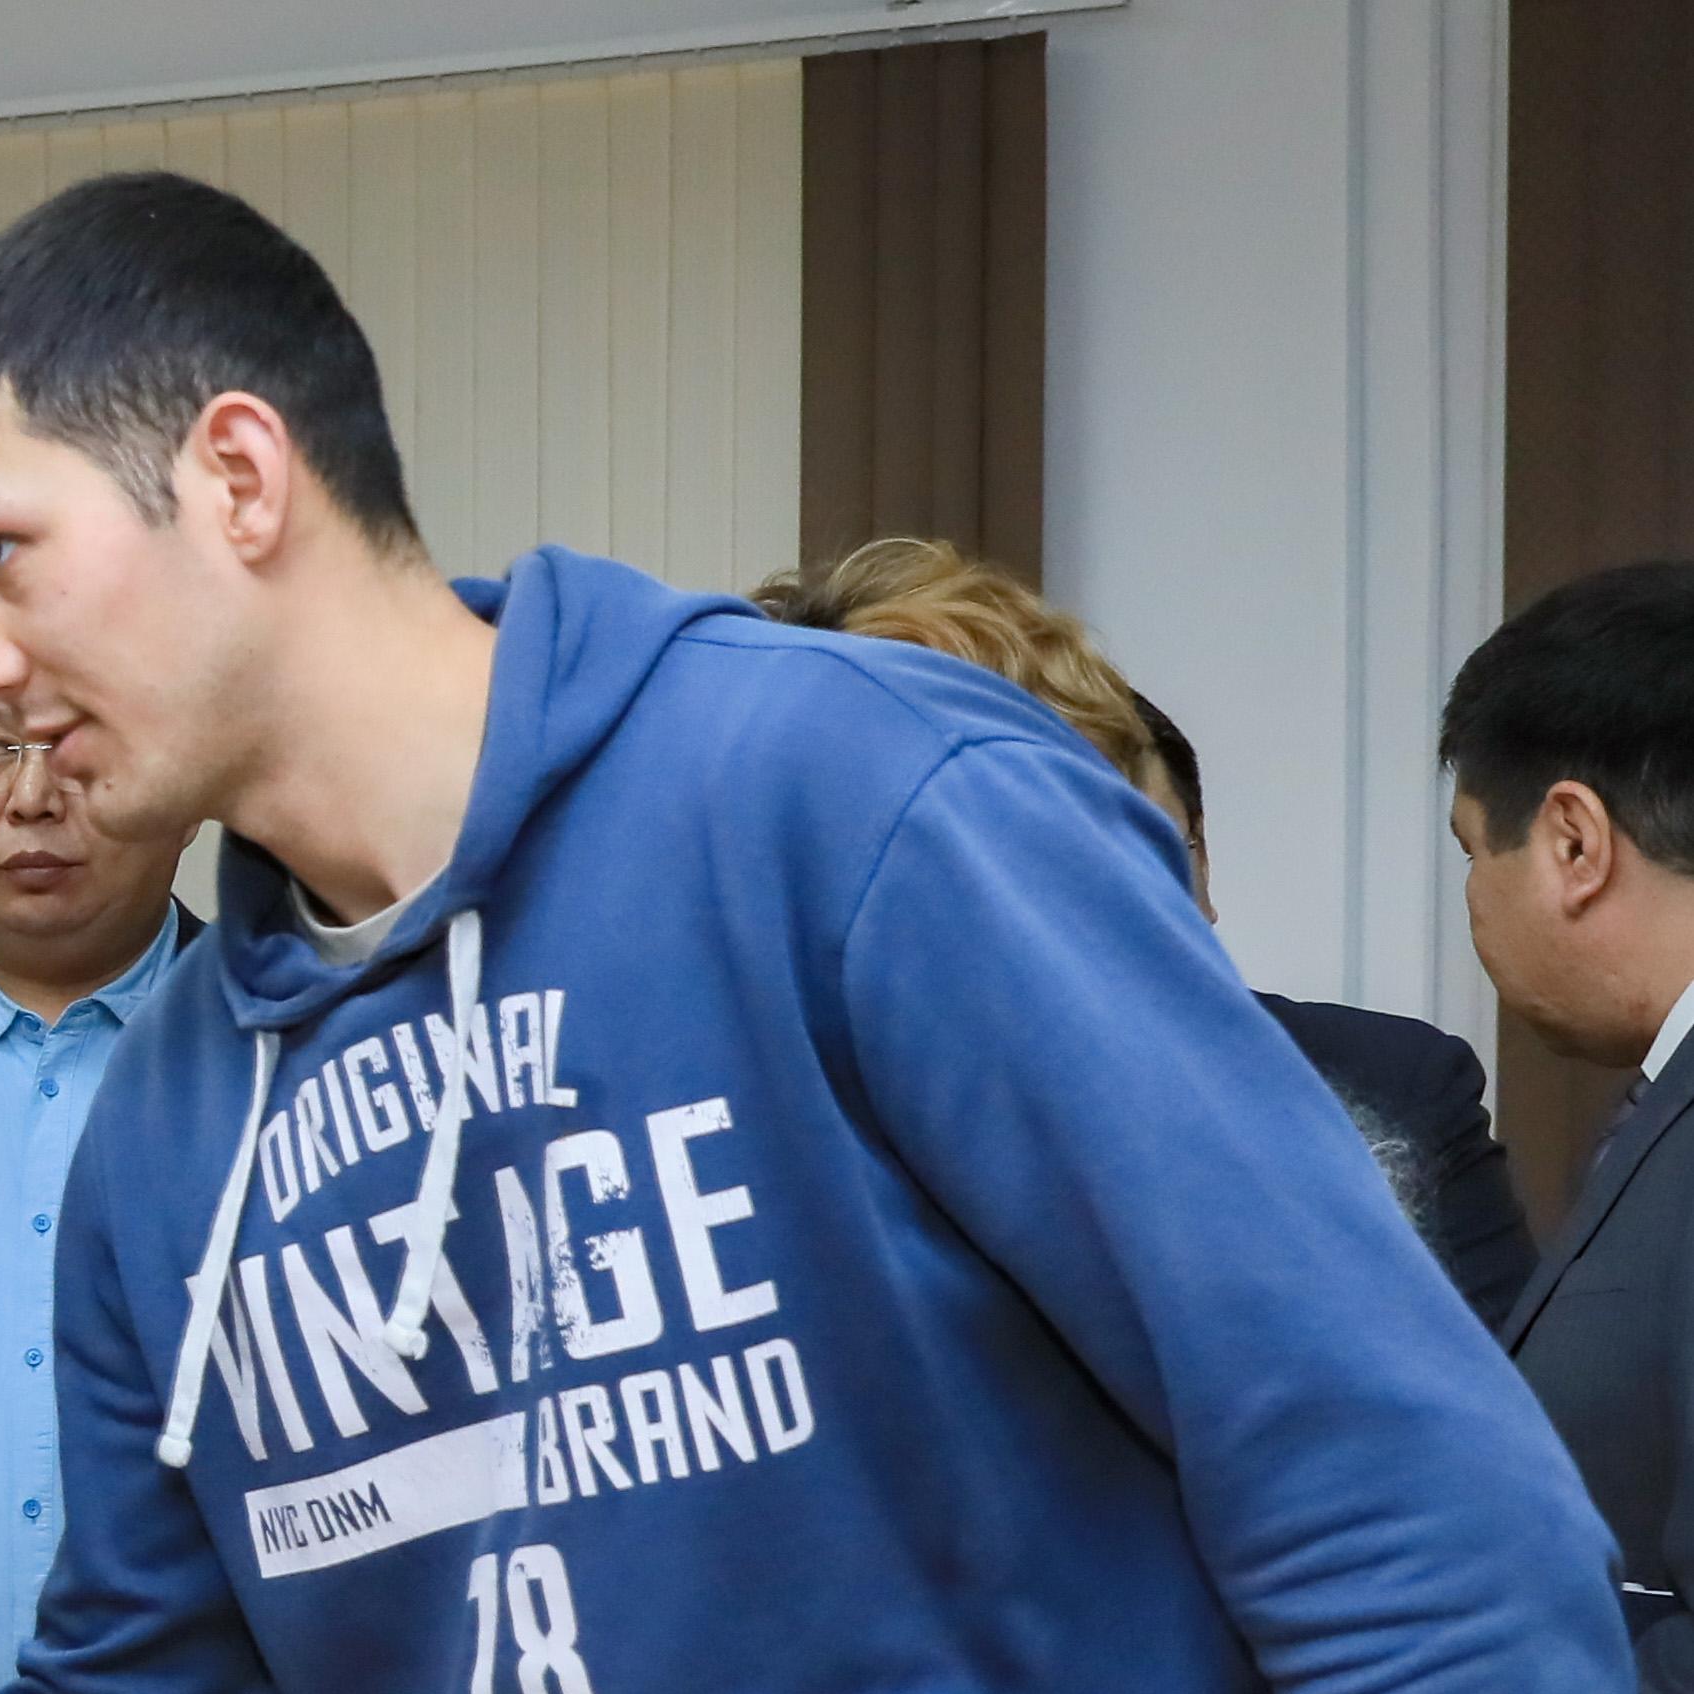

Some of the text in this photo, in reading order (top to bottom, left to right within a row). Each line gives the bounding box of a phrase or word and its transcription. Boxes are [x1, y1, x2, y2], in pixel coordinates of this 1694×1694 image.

[258, 988, 579, 1223] ORIGINAL
[536, 1336, 816, 1506] BRAND
[258, 1480, 393, 1554] NYC DNM
